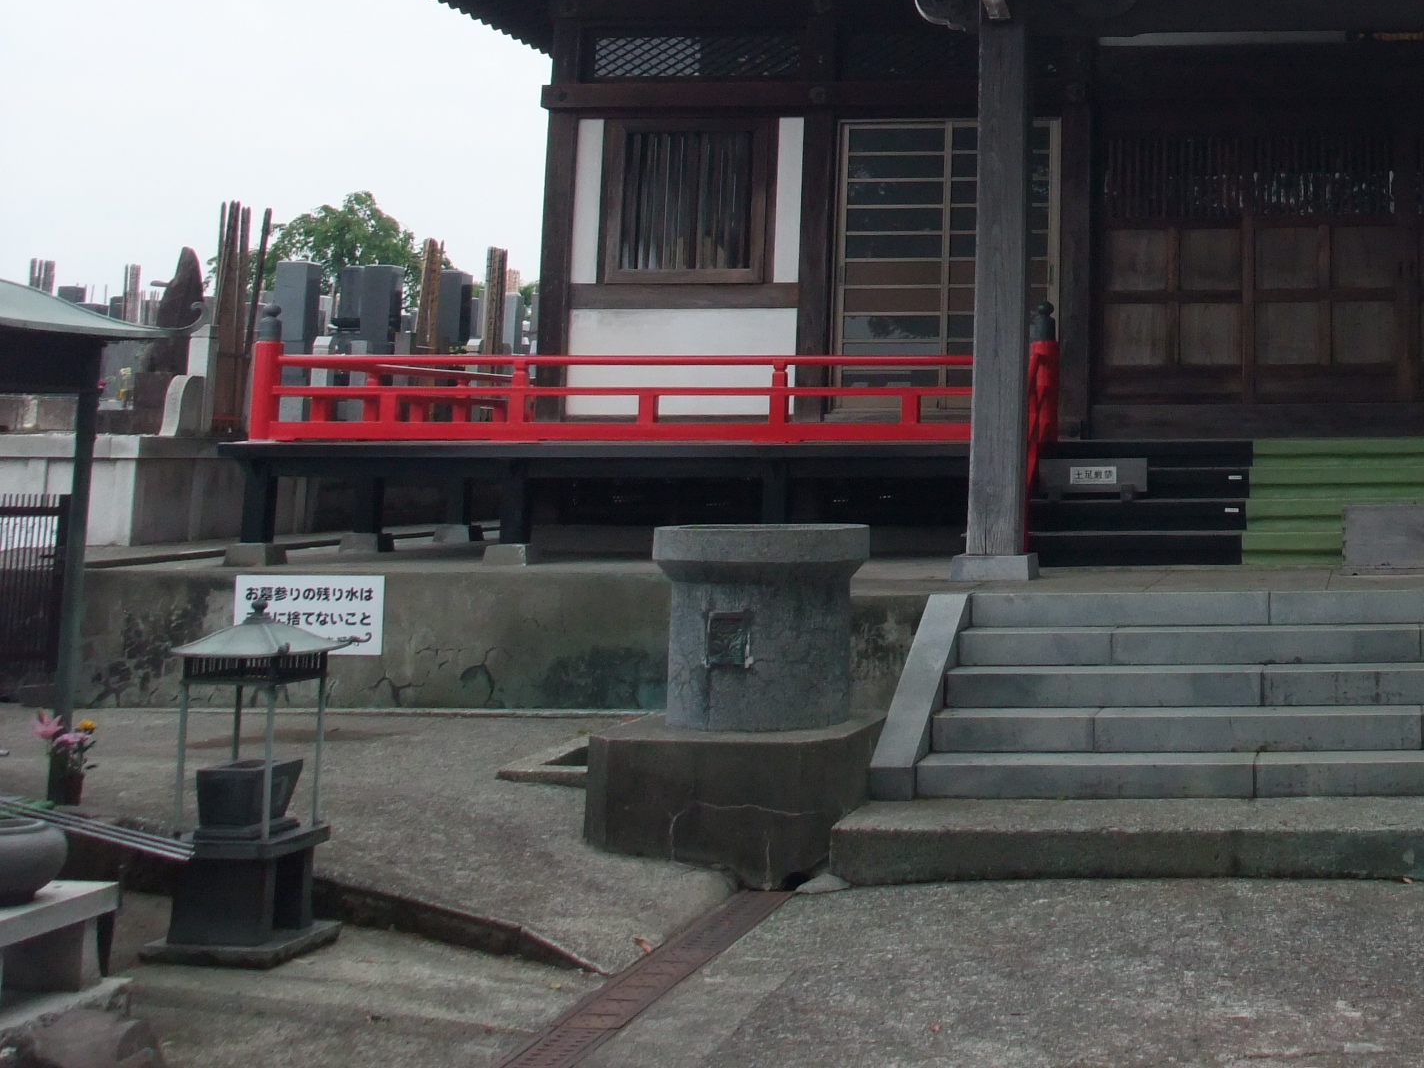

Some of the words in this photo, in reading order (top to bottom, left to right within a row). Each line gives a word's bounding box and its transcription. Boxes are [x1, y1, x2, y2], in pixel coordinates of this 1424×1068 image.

[245, 586, 373, 601] お墓参りの残り水は
[246, 612, 372, 626] に捨てないこと
